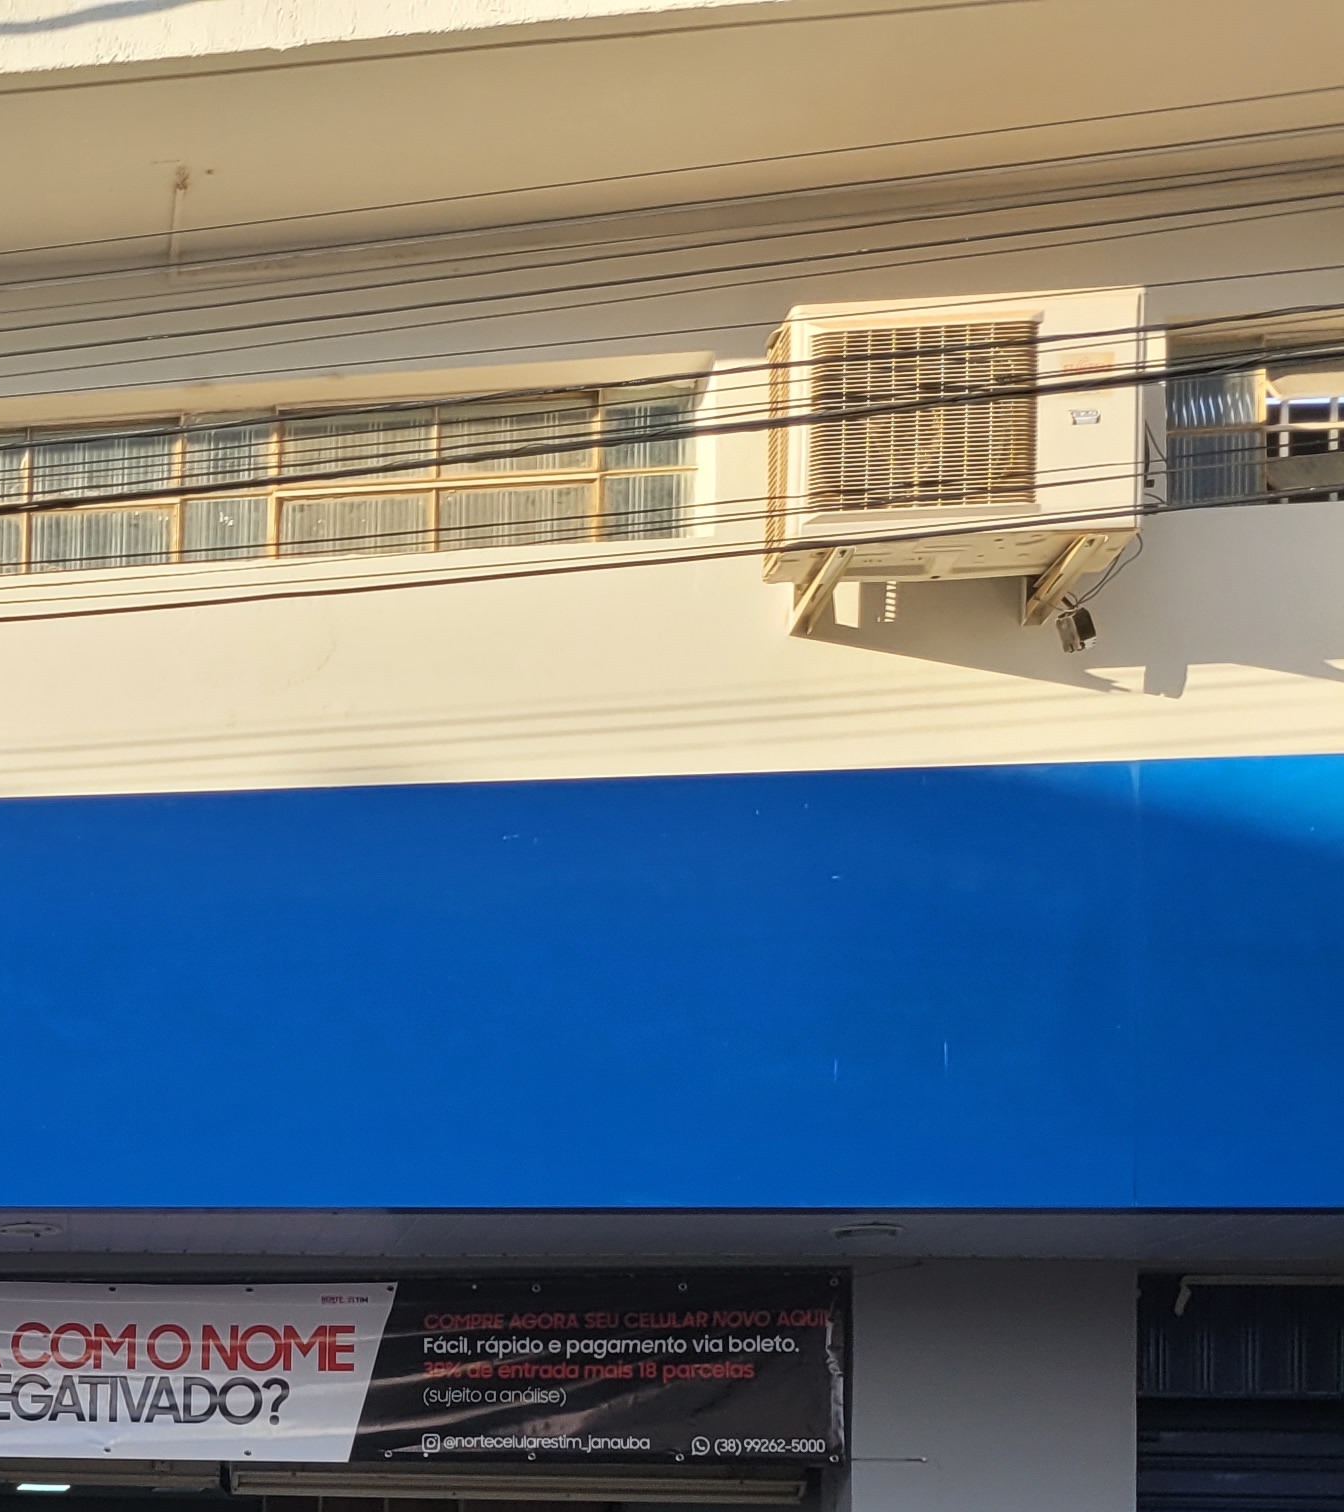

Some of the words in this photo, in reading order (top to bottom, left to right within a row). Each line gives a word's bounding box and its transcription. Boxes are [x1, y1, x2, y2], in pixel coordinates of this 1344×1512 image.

[424, 1314, 504, 1330] COMPRE
[509, 1313, 579, 1329] AGORA
[584, 1313, 619, 1329] SEU
[624, 1311, 708, 1328] CELULAR
[712, 1311, 771, 1327] NOVO
[11, 1322, 137, 1370] COM
[146, 1323, 192, 1371] O
[201, 1323, 355, 1372] NOME
[423, 1335, 472, 1356] Fácil,
[476, 1335, 543, 1358] rápido
[548, 1340, 562, 1354] e
[566, 1336, 687, 1359] pagamento
[693, 1335, 723, 1353] via
[729, 1335, 800, 1353] boleto.
[467, 1362, 493, 1378] de
[498, 1361, 579, 1379] entrada
[584, 1360, 634, 1379] mais
[638, 1362, 657, 1378] 18
[663, 1361, 755, 1383] parcelas
[423, 1386, 482, 1406] (sujeito
[484, 1390, 497, 1402] a
[499, 1386, 567, 1406] análise)
[443, 1434, 651, 1453] @nortecelularestim_janauba
[714, 1438, 742, 1456] (38)
[743, 1439, 826, 1453] 99262-5000
